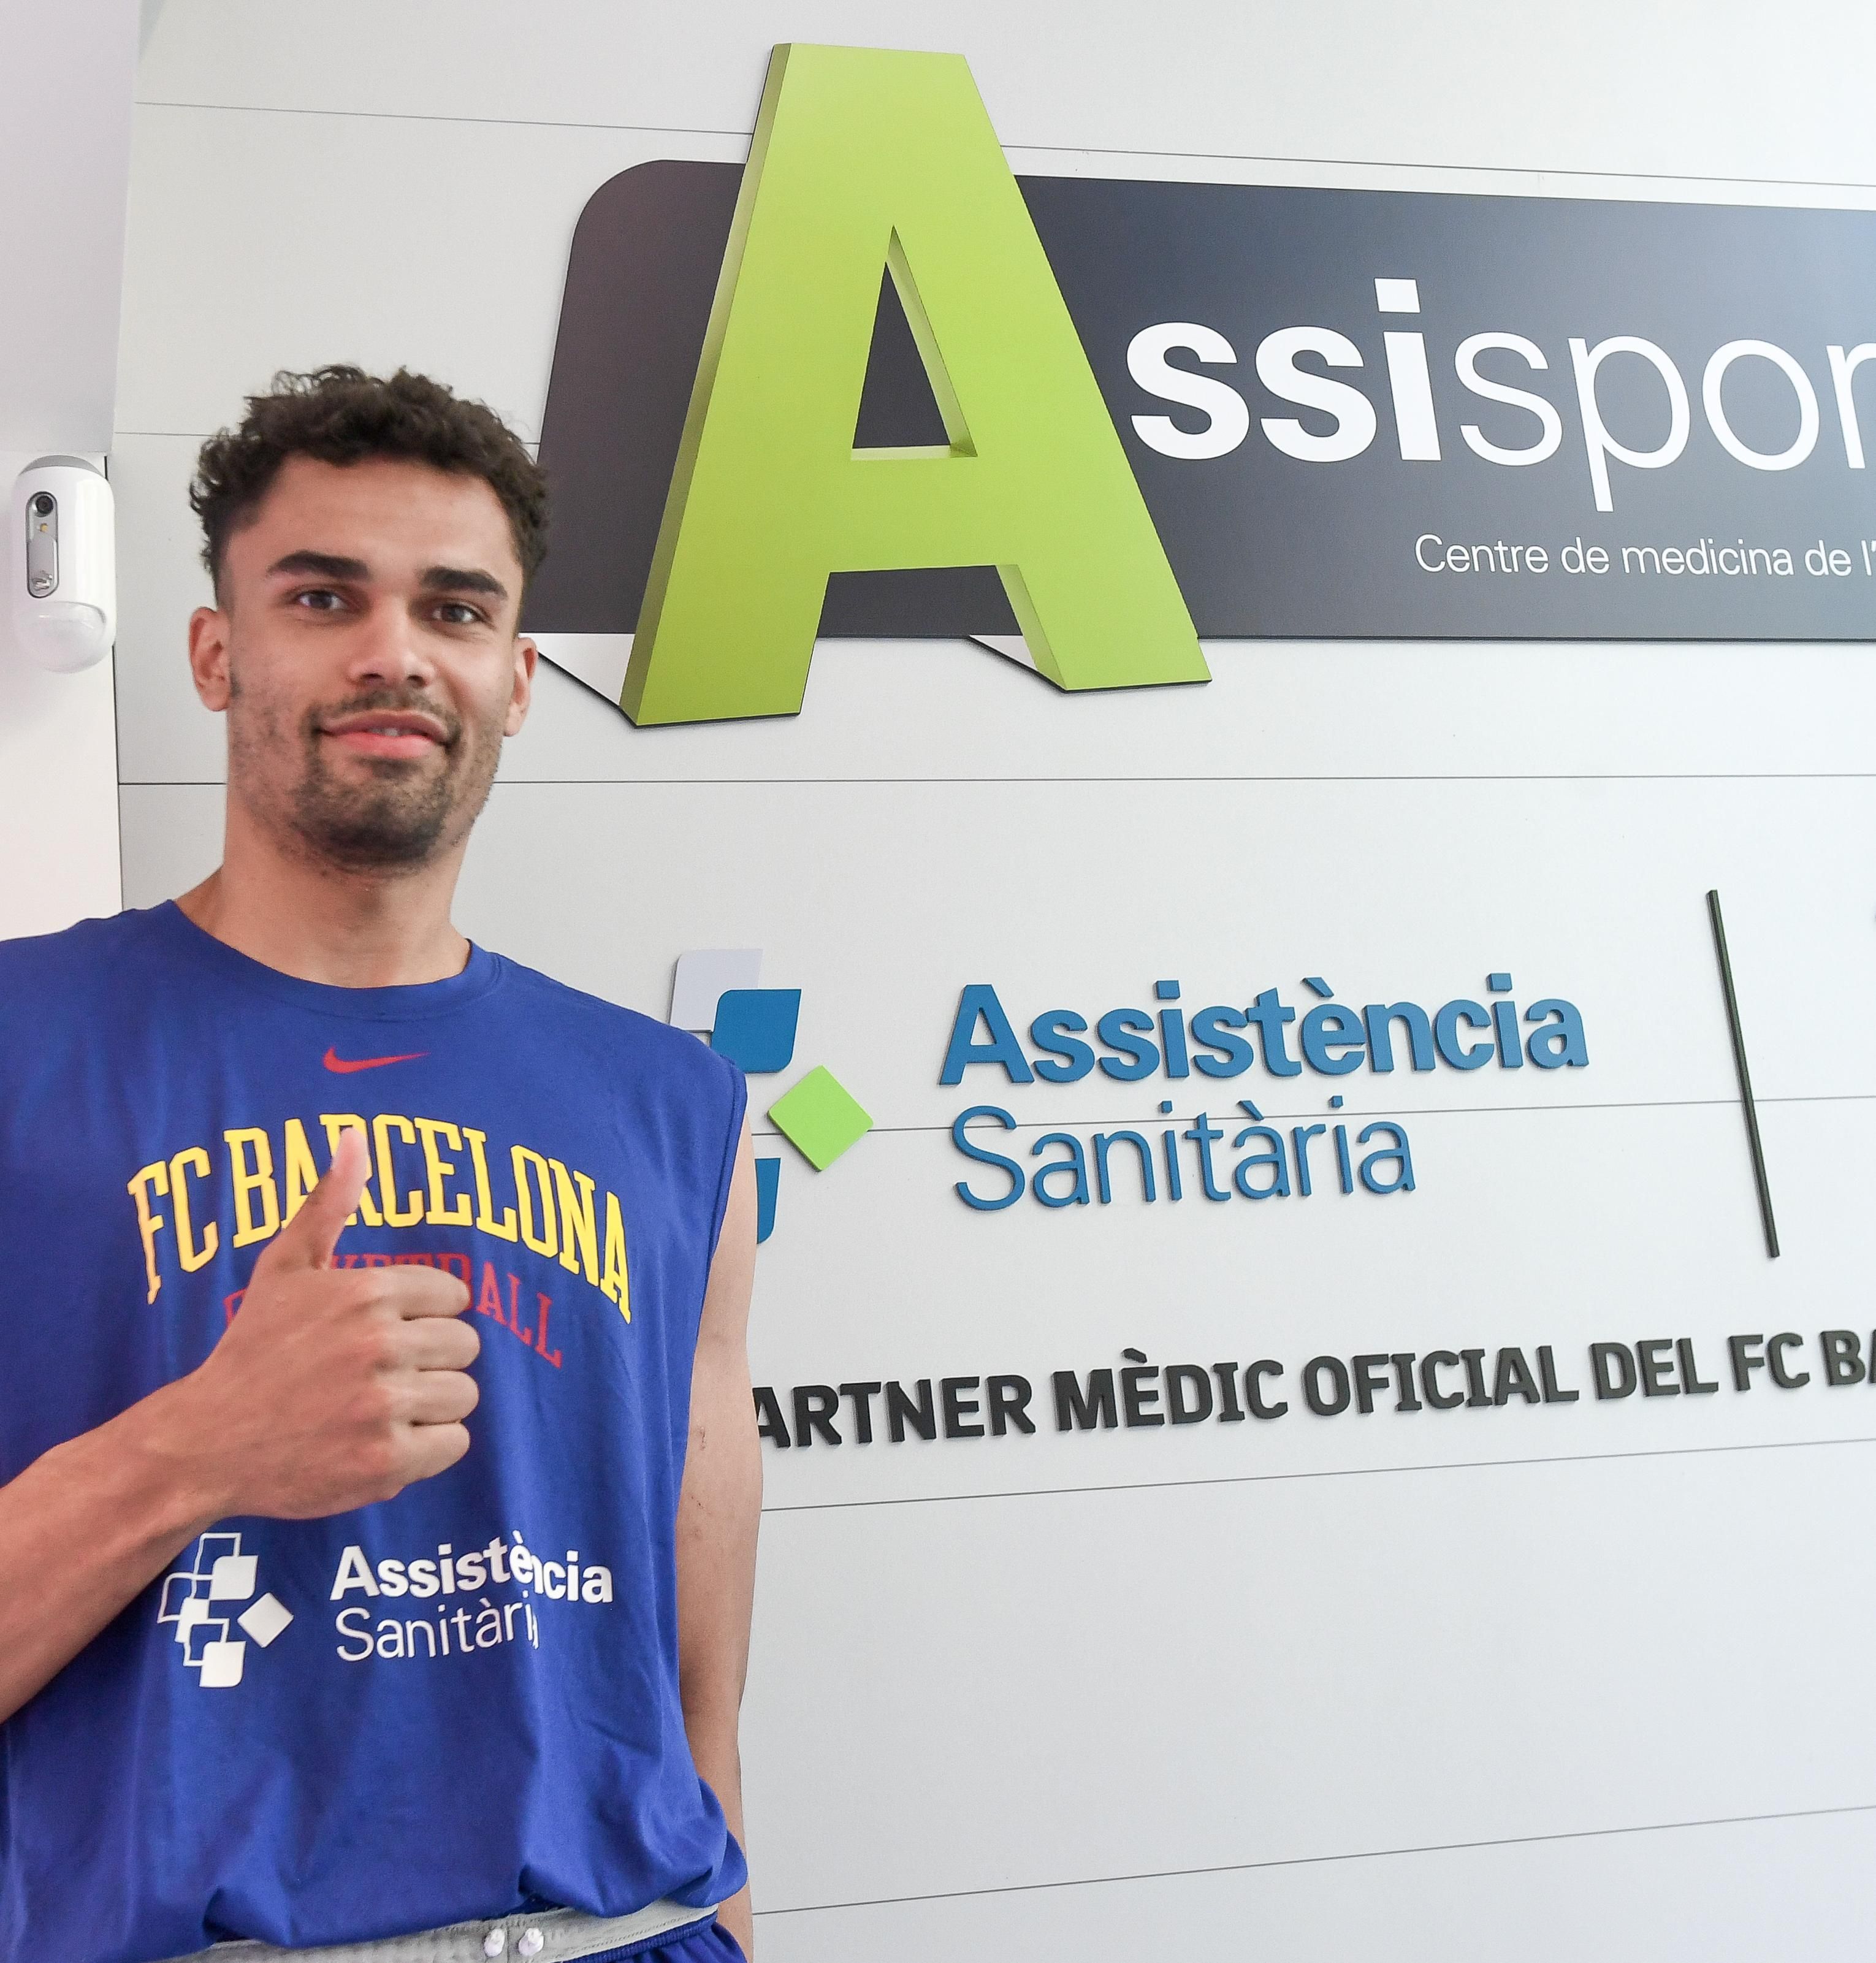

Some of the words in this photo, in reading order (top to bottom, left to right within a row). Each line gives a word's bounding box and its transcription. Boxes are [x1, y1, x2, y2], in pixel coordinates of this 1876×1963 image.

[1414, 533, 1549, 573] Centre
[1560, 536, 1610, 574] de
[1622, 538, 1794, 576] medicina
[1804, 539, 1852, 576] de
[939, 972, 1589, 1086] Assistència
[953, 1095, 1416, 1212] Sanitària
[128, 1146, 217, 1305] FC
[1052, 1349, 1289, 1432] MÈDIC
[1303, 1345, 1580, 1415] OFICIAL
[1589, 1338, 1719, 1400] DEL
[1728, 1332, 1810, 1392] FC
[1820, 1329, 1876, 1386] B
[335, 1590, 539, 1661] Sanitàri
